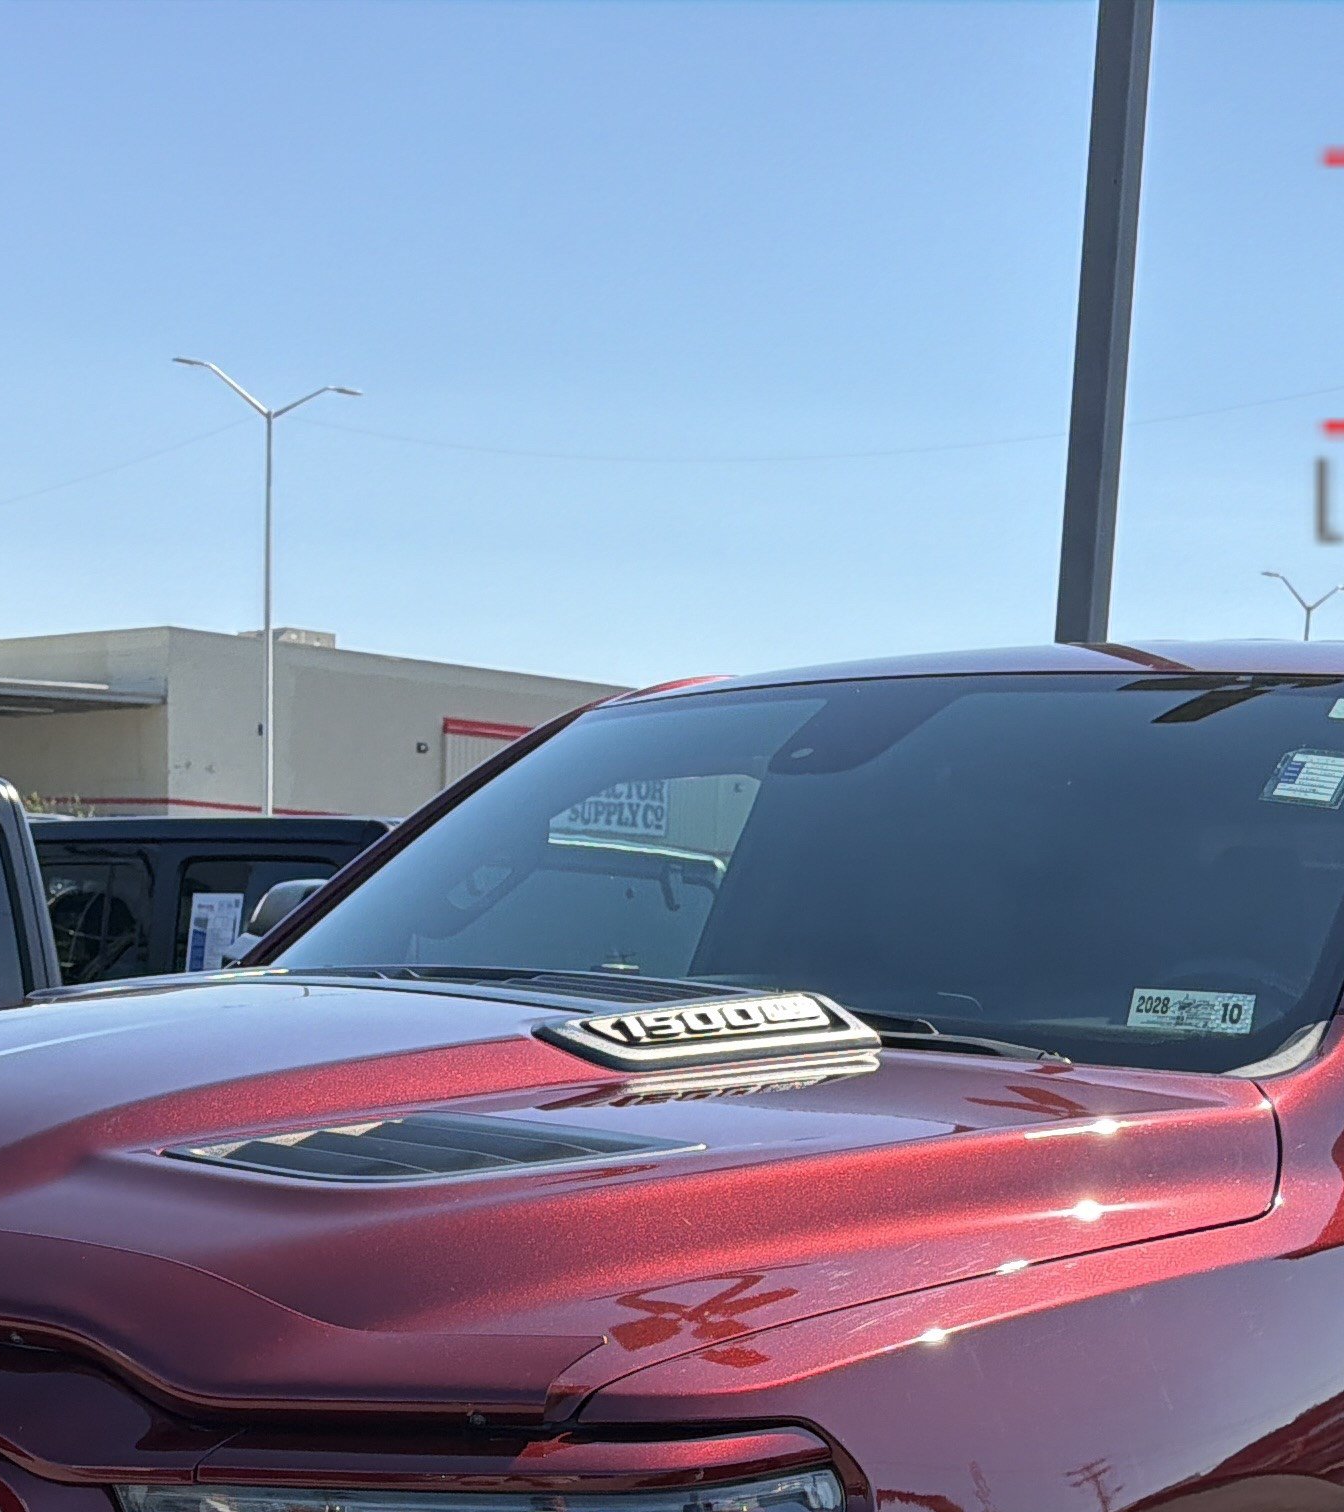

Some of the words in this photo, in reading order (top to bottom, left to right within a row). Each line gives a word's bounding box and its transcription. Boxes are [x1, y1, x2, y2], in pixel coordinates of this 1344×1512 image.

[567, 801, 640, 828] SUPPLY
[611, 1006, 755, 1043] 1500
[1136, 995, 1171, 1015] 2028
[1220, 1002, 1243, 1025] 10
